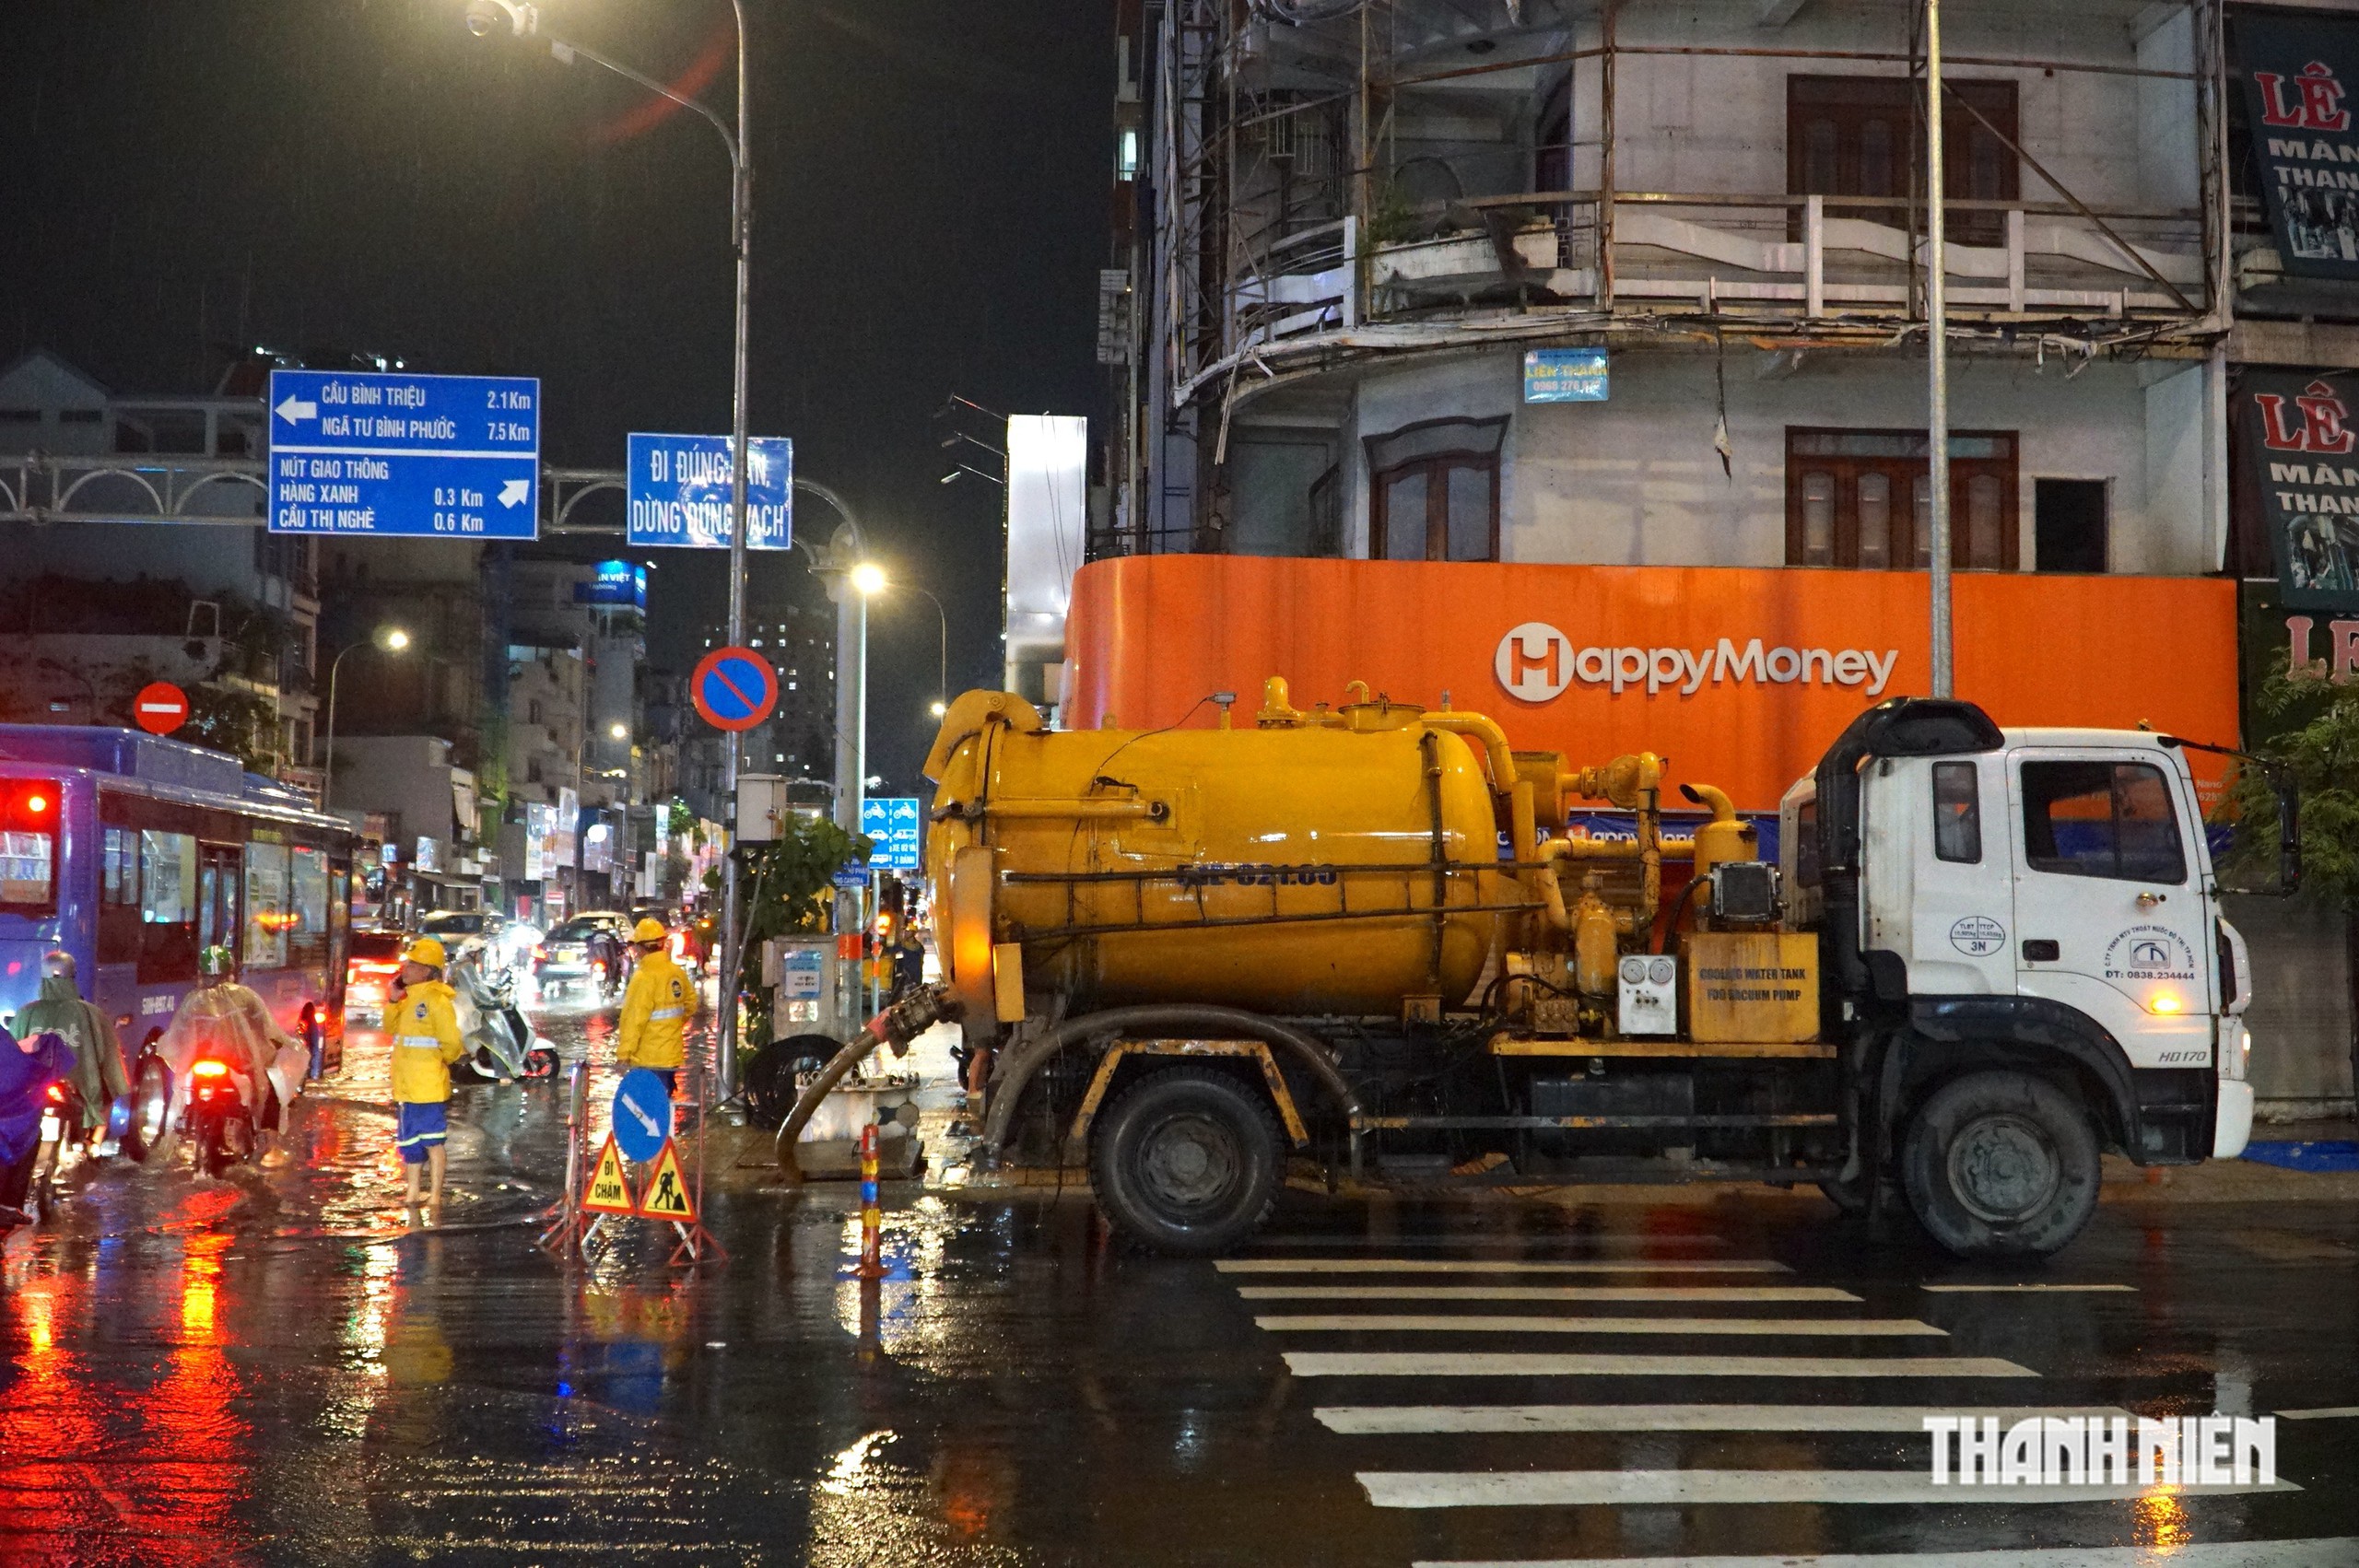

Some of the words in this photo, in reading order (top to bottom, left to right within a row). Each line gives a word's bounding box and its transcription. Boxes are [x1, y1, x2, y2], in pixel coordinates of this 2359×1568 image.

[2254, 61, 2351, 131] LÊ
[322, 380, 346, 405] CẦU
[351, 382, 381, 405] BÌNH
[385, 384, 426, 410] TRIỆU
[322, 415, 350, 437] NGÃ
[353, 416, 373, 438] TƯ
[376, 415, 405, 439] BÌNH
[409, 415, 456, 439] PHƯỚC
[2255, 380, 2354, 453] LÊ
[280, 456, 307, 478] NÚT
[311, 460, 341, 479] GIAO
[346, 457, 390, 480] THÔNG
[651, 450, 668, 483] ĐI
[675, 443, 725, 486] ĐÚNG
[280, 481, 315, 503] HÀNG
[320, 485, 358, 504] XANH
[434, 487, 455, 507] 0.3
[461, 488, 484, 508] Km
[279, 504, 305, 528] CẦU
[310, 509, 334, 532] THỊ
[337, 507, 375, 529] NGHÈ
[433, 512, 455, 532] 0.6
[461, 513, 484, 532] Km
[632, 492, 682, 533] DỪNG
[1970, 941, 1987, 953] 3N
[1780, 968, 1806, 980] TANK
[1773, 989, 1802, 1001] PUMP
[604, 1161, 614, 1176] ĐI
[595, 1182, 621, 1203] CHẬM
